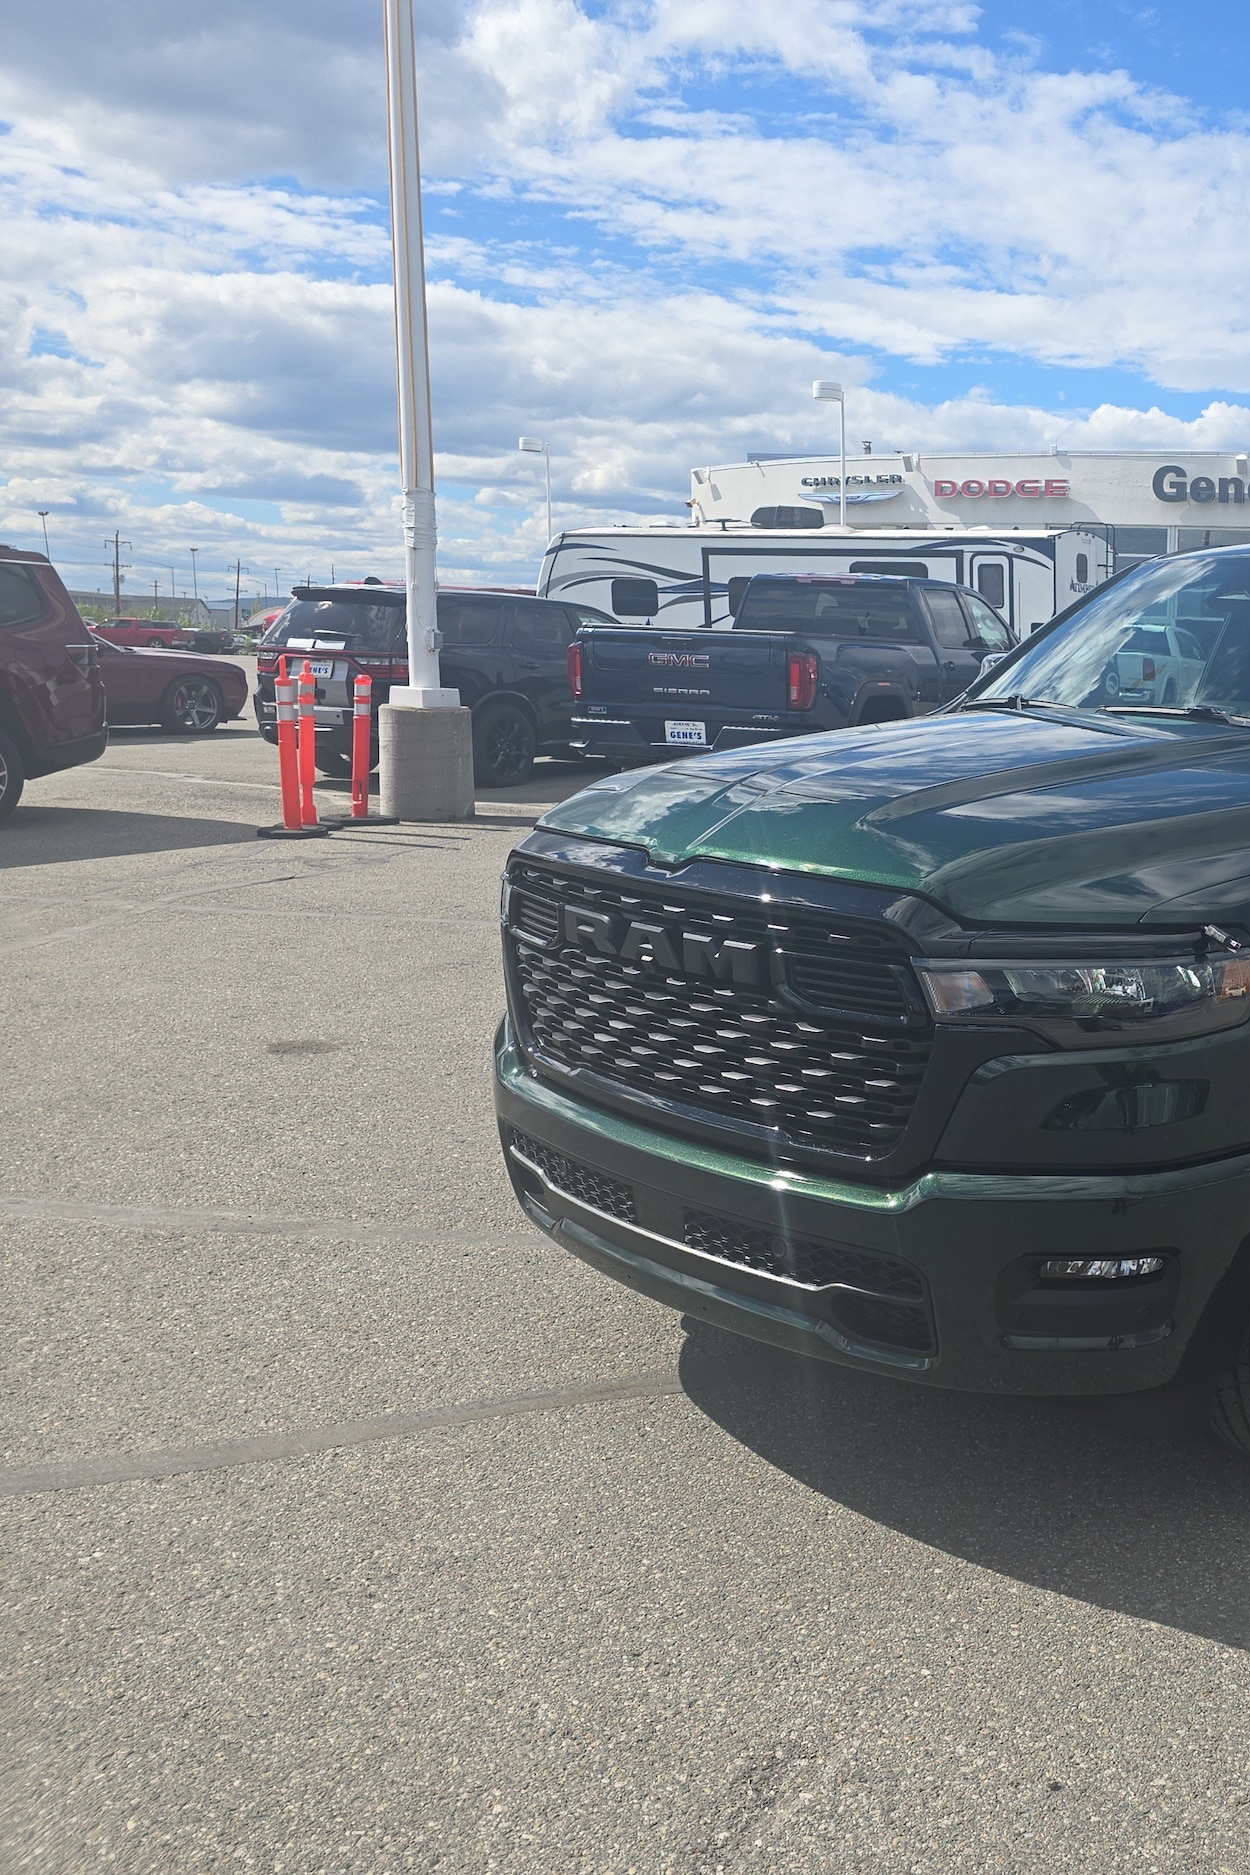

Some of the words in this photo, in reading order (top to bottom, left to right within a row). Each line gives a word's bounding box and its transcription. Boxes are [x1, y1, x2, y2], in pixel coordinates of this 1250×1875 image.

[934, 480, 1070, 498] DODGE
[647, 652, 709, 668] GMC
[670, 731, 702, 740] GENE'S
[563, 903, 759, 985] RAM
